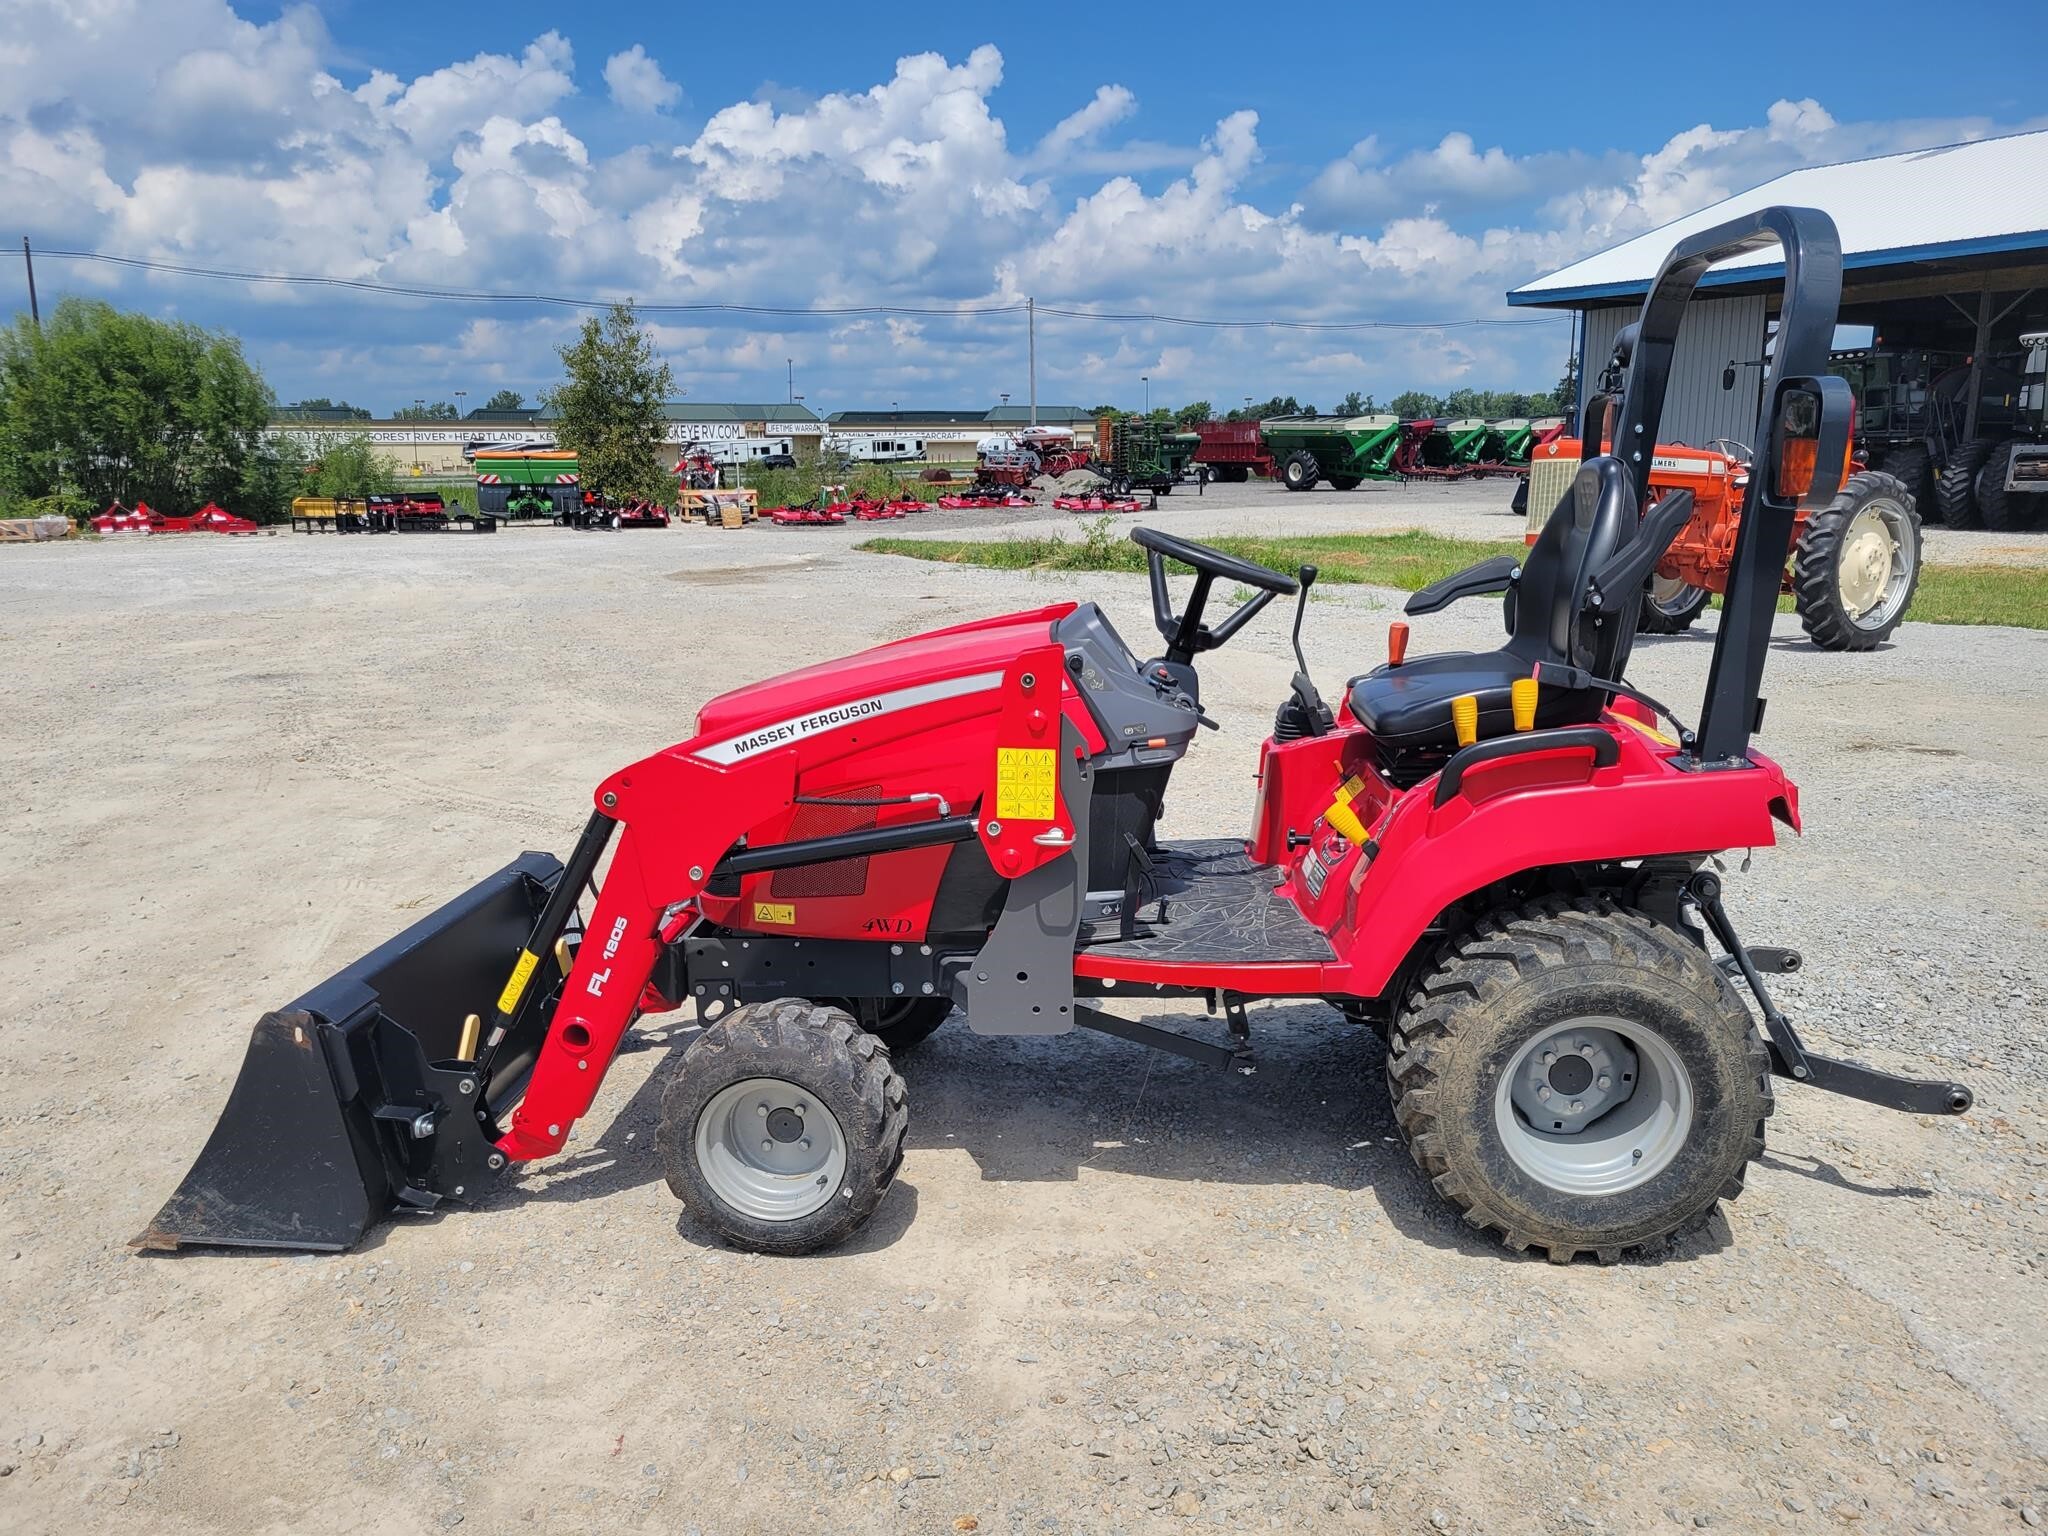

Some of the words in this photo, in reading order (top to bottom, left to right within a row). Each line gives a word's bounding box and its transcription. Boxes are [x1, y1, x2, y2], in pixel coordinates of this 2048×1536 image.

[367, 432, 410, 441] FOREST
[414, 432, 446, 441] RIVER
[454, 432, 523, 441] HEARTLAND
[702, 424, 739, 438] RV.COM
[1651, 459, 1676, 467] LMERS
[733, 723, 797, 755] MASSEY
[800, 698, 884, 733] FERGUSON
[862, 918, 912, 933] 4WD
[586, 967, 611, 997] FL
[602, 916, 628, 960] 1805
